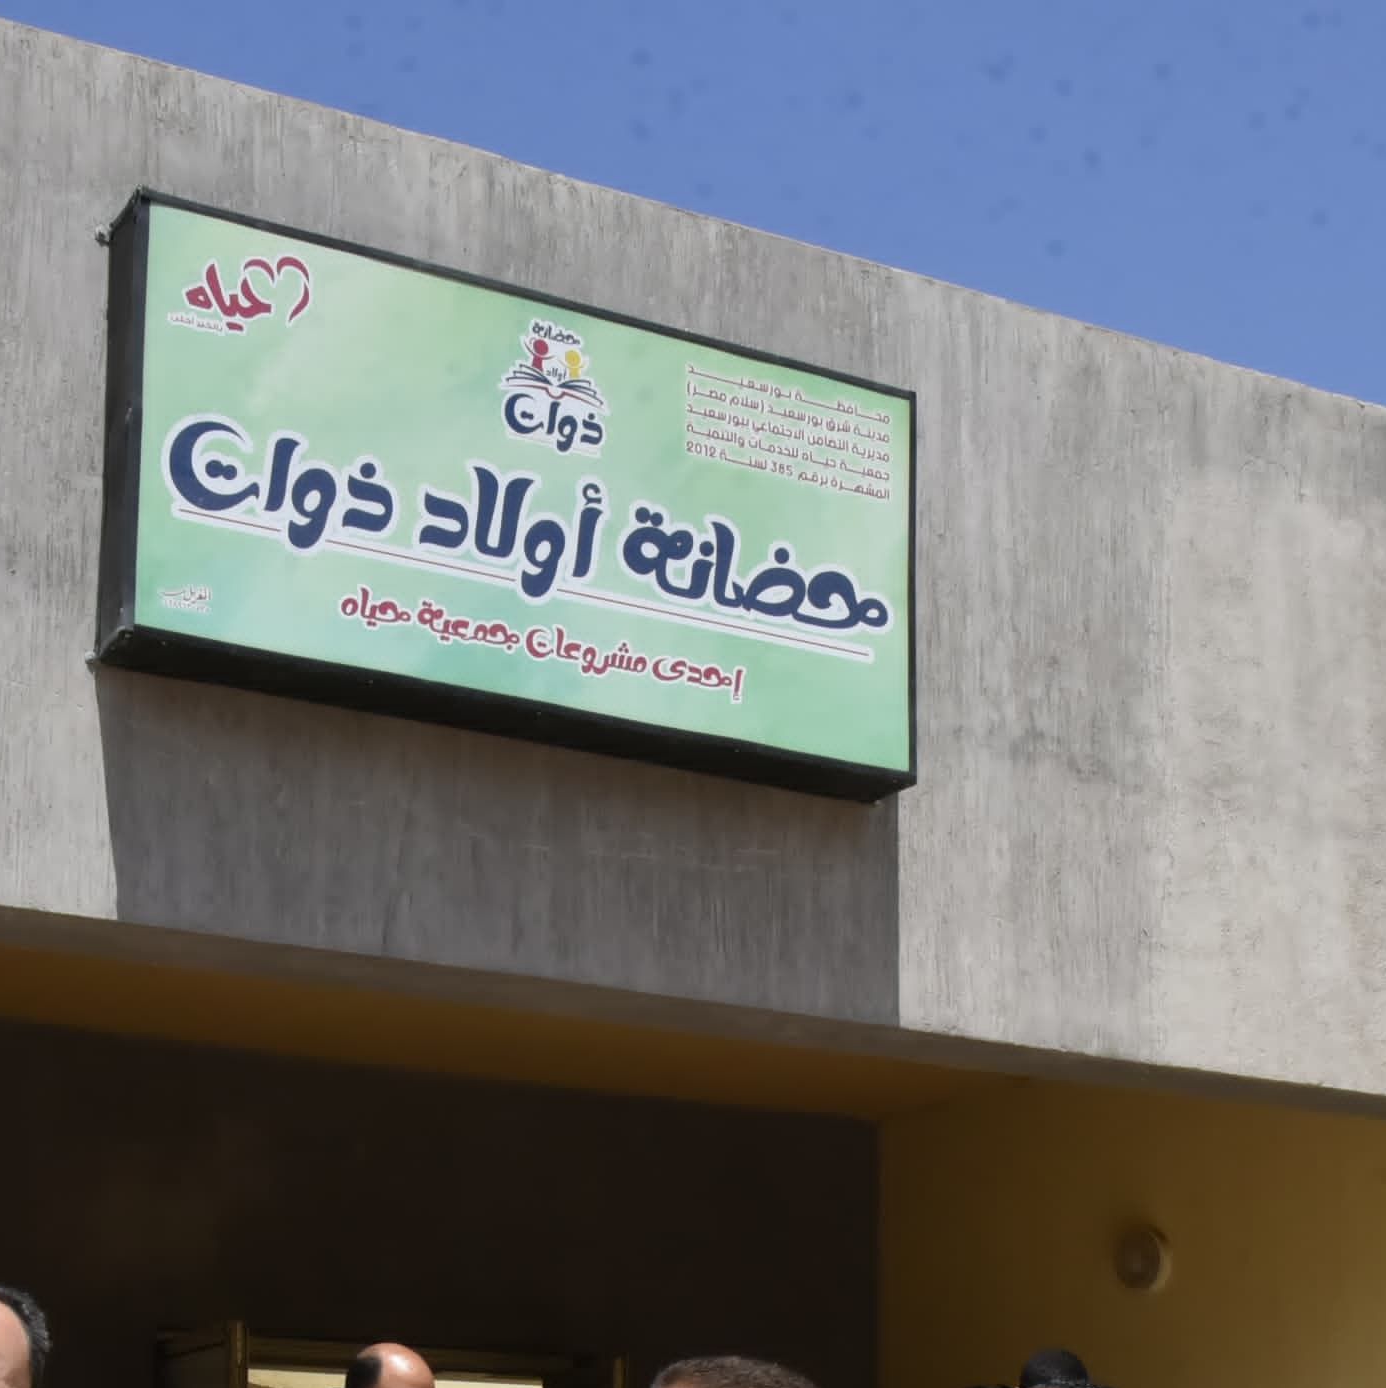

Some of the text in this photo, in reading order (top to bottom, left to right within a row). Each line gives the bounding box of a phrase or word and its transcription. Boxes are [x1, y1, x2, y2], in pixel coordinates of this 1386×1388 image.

[532, 321, 581, 345] حضانة
[688, 364, 890, 424] محافظة بورسعيد
[504, 392, 604, 453] ذوات
[767, 403, 823, 428] بورسعيد
[825, 416, 851, 433] شرق
[686, 421, 746, 448] والتنمية
[807, 432, 849, 452] التضامن
[853, 424, 890, 443] مدينة
[686, 440, 717, 458] 2012
[719, 448, 768, 470] لسنة
[748, 435, 799, 459] للخدمات
[851, 443, 890, 463] مديرية
[797, 471, 829, 488] برقم
[839, 459, 890, 481] جمعية
[830, 476, 890, 500] المشهرة
[169, 420, 890, 630] حضانة أولاد ذوات
[417, 601, 520, 651] جمعية
[525, 627, 647, 675] مشروعات
[652, 657, 743, 700] إحدى
